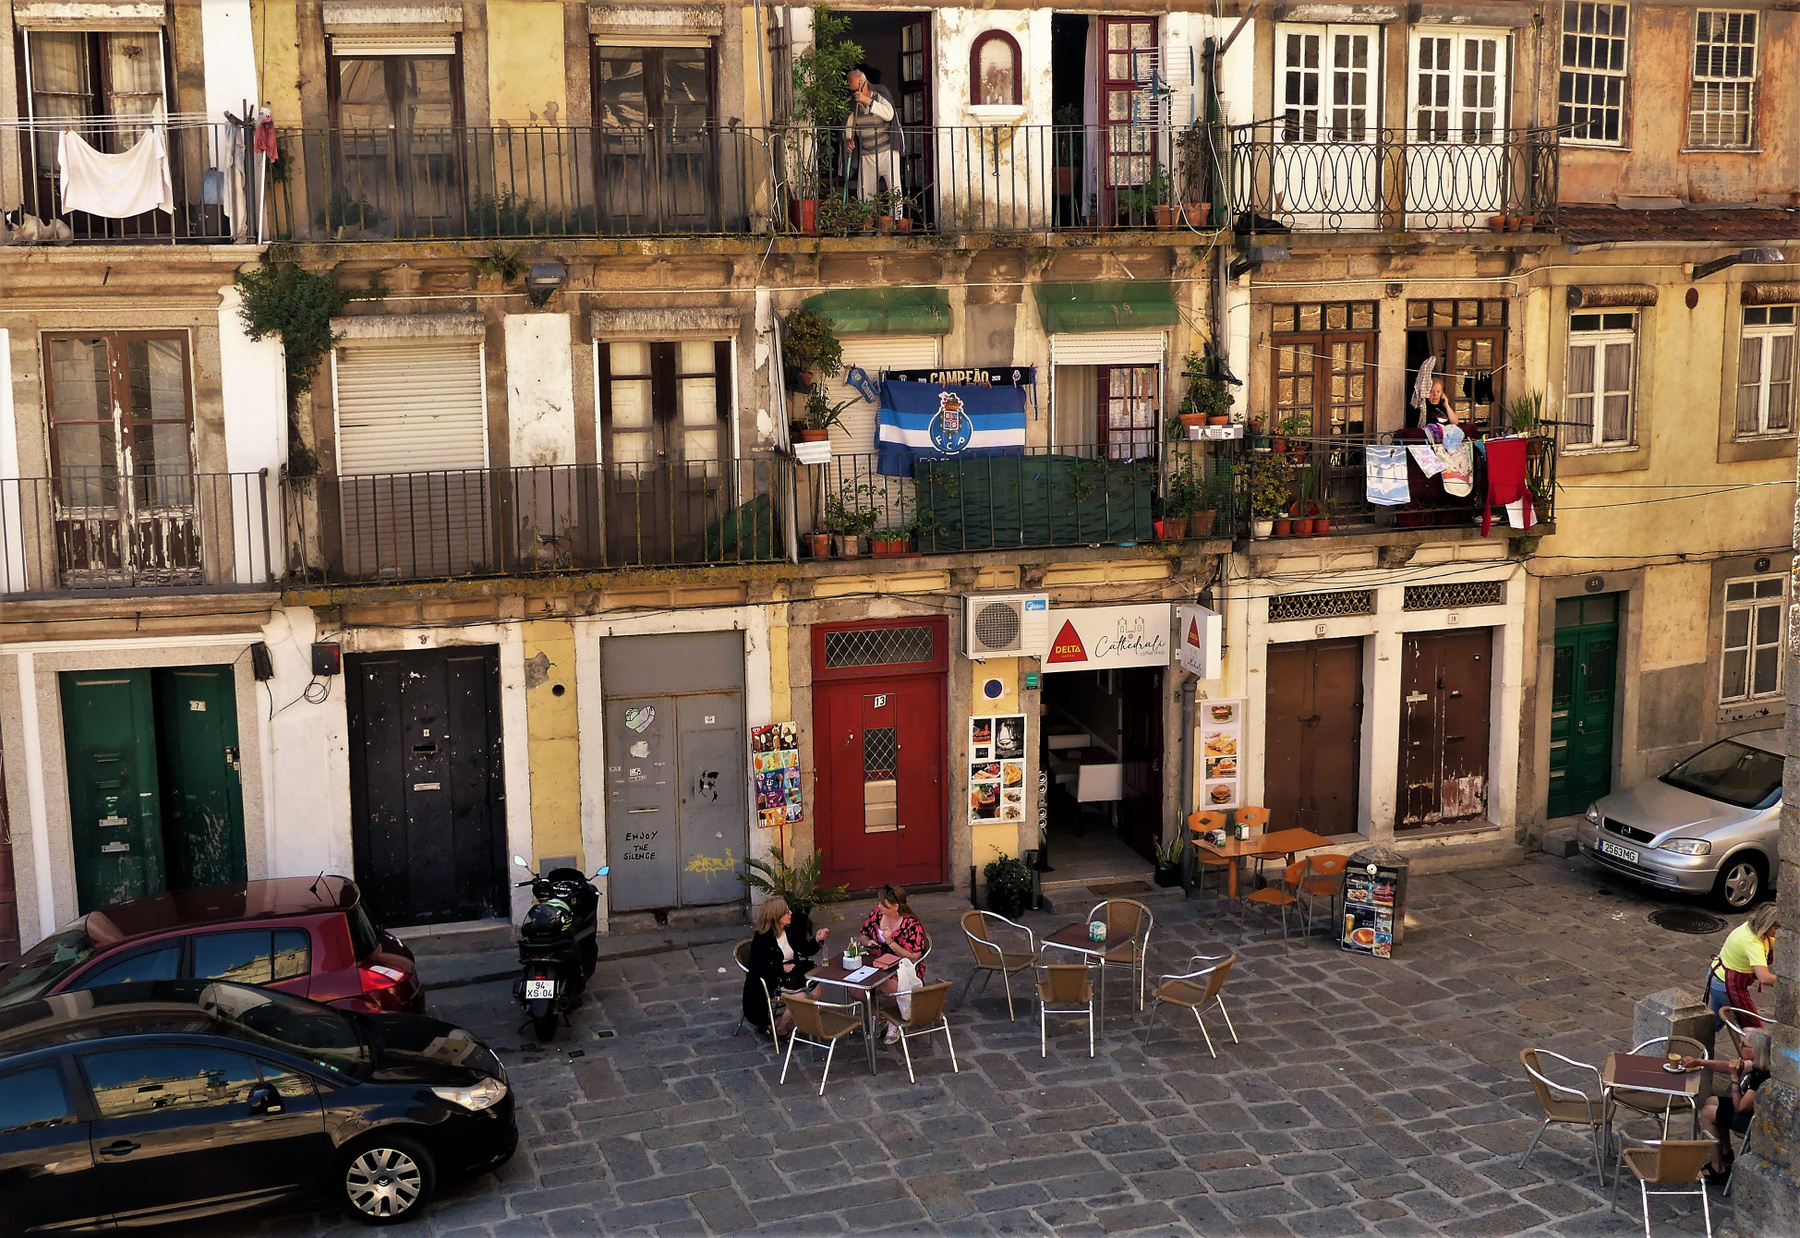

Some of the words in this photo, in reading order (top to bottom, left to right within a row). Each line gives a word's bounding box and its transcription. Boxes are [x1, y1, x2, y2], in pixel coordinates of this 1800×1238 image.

[930, 368, 989, 386] CAMPEÃO
[419, 634, 428, 645] 9
[1055, 645, 1081, 654] DELTA
[876, 696, 885, 706] 13
[625, 830, 658, 841] ENJOY
[633, 843, 649, 852] THE
[535, 981, 545, 990] 94
[527, 990, 540, 998] XS
[542, 989, 553, 997] 04
